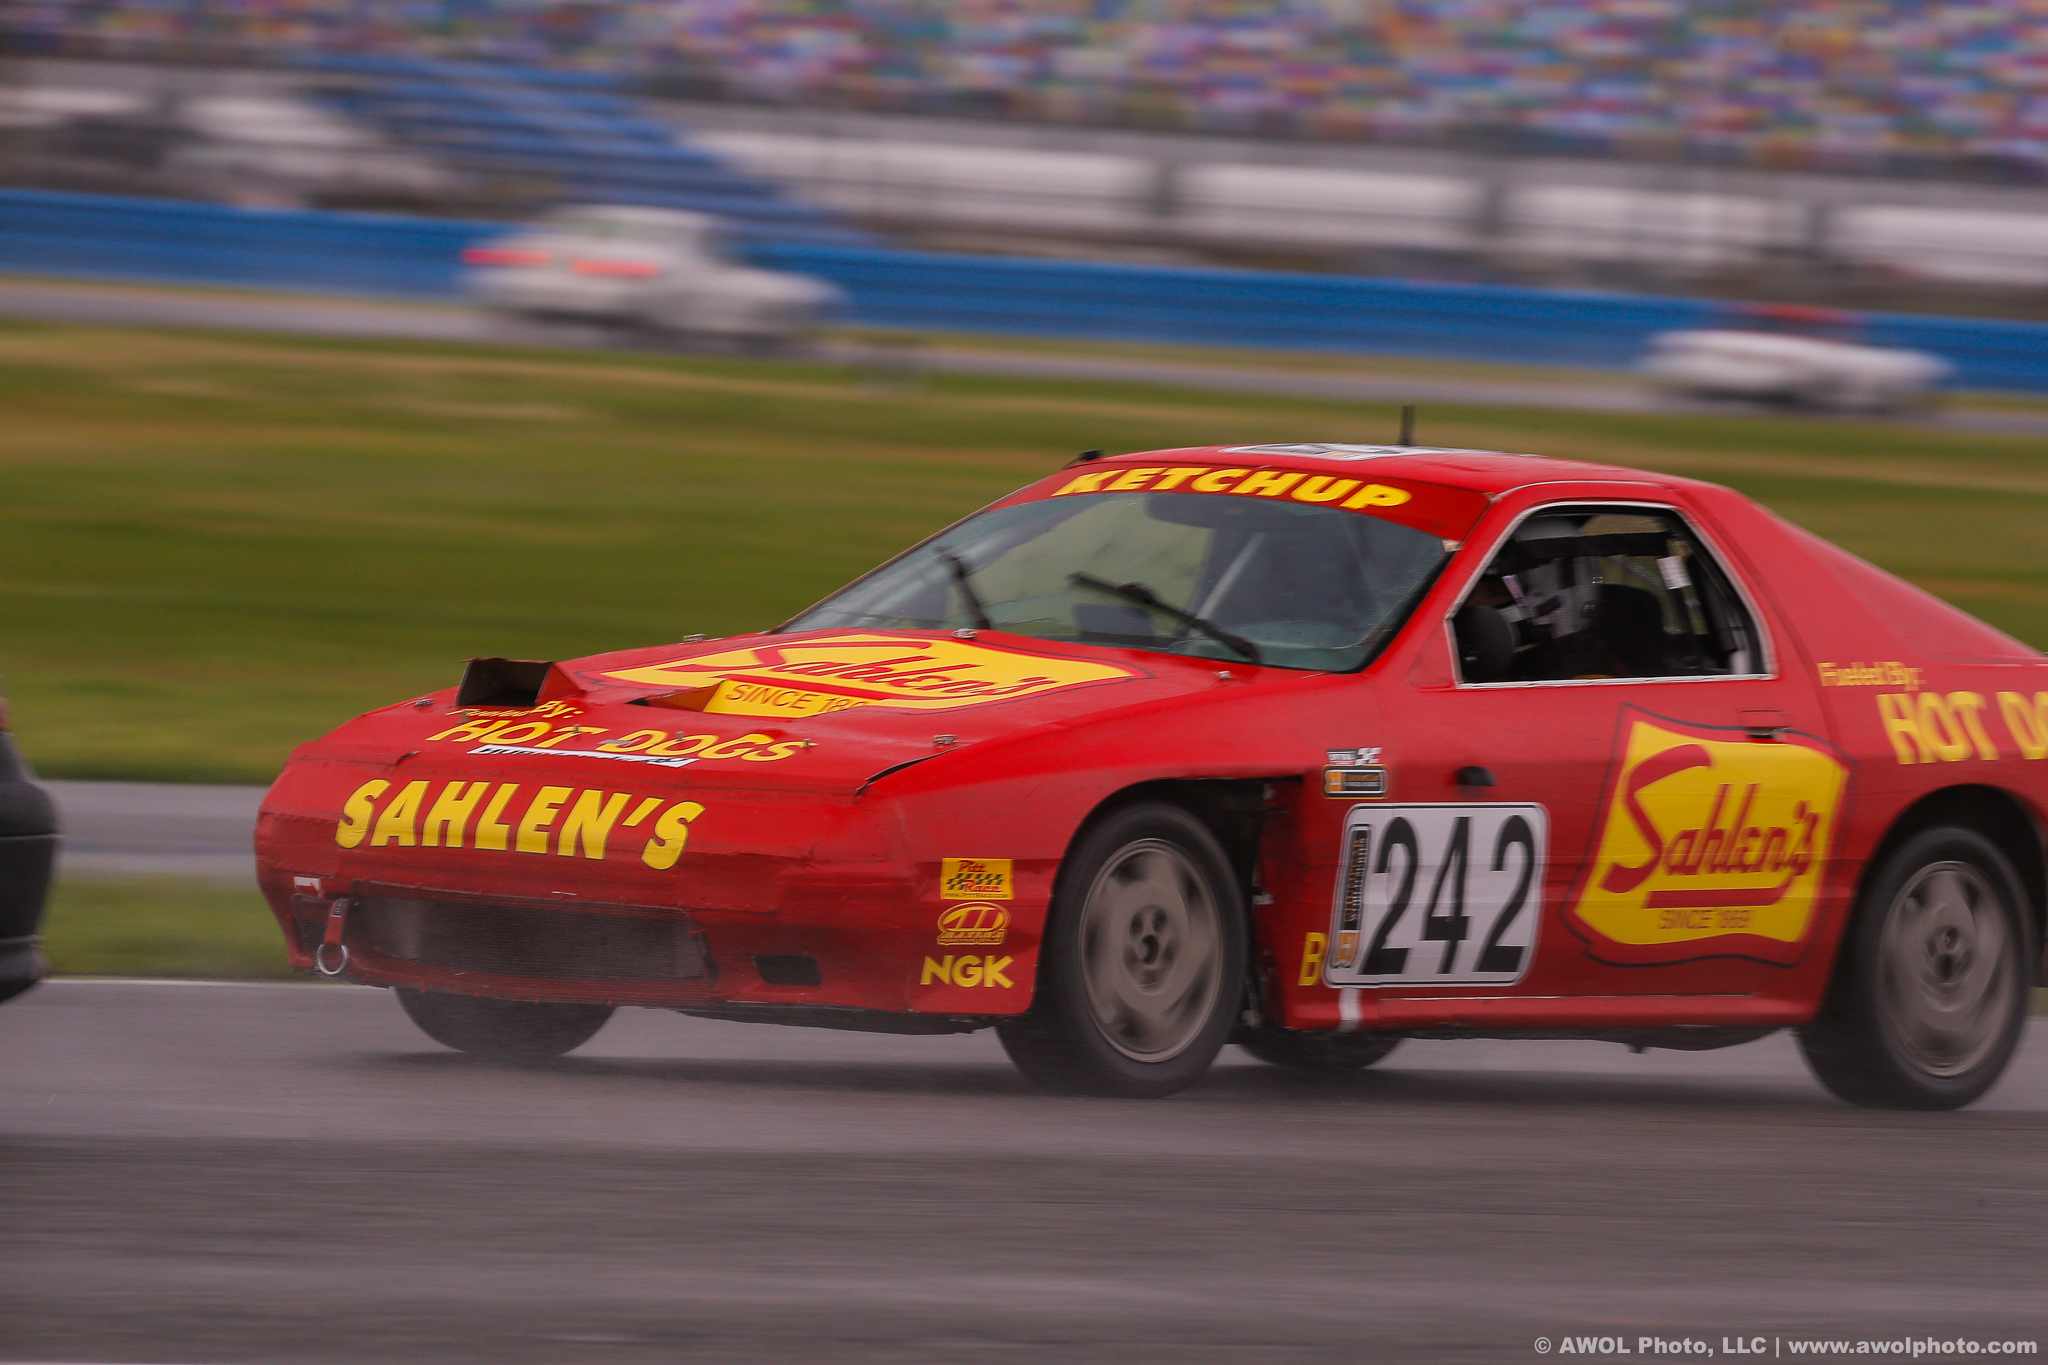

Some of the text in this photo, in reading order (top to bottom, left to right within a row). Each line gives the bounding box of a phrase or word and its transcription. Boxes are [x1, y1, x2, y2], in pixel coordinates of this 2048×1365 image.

[1050, 467, 1412, 509] KETCHUP
[530, 700, 584, 719] By:
[725, 684, 819, 709] SINCE
[425, 719, 610, 748] HOT
[595, 729, 807, 761] DOGS
[1876, 691, 1999, 765] HOT
[335, 779, 706, 870] SAHLEN'S
[1598, 744, 1822, 893] Sahlen's
[957, 860, 987, 872] Pitt
[961, 880, 1003, 892] Race
[1357, 815, 1536, 976] 242
[1659, 909, 1714, 929] SINCE
[920, 955, 1014, 989] NGK
[1298, 932, 1327, 986] B
